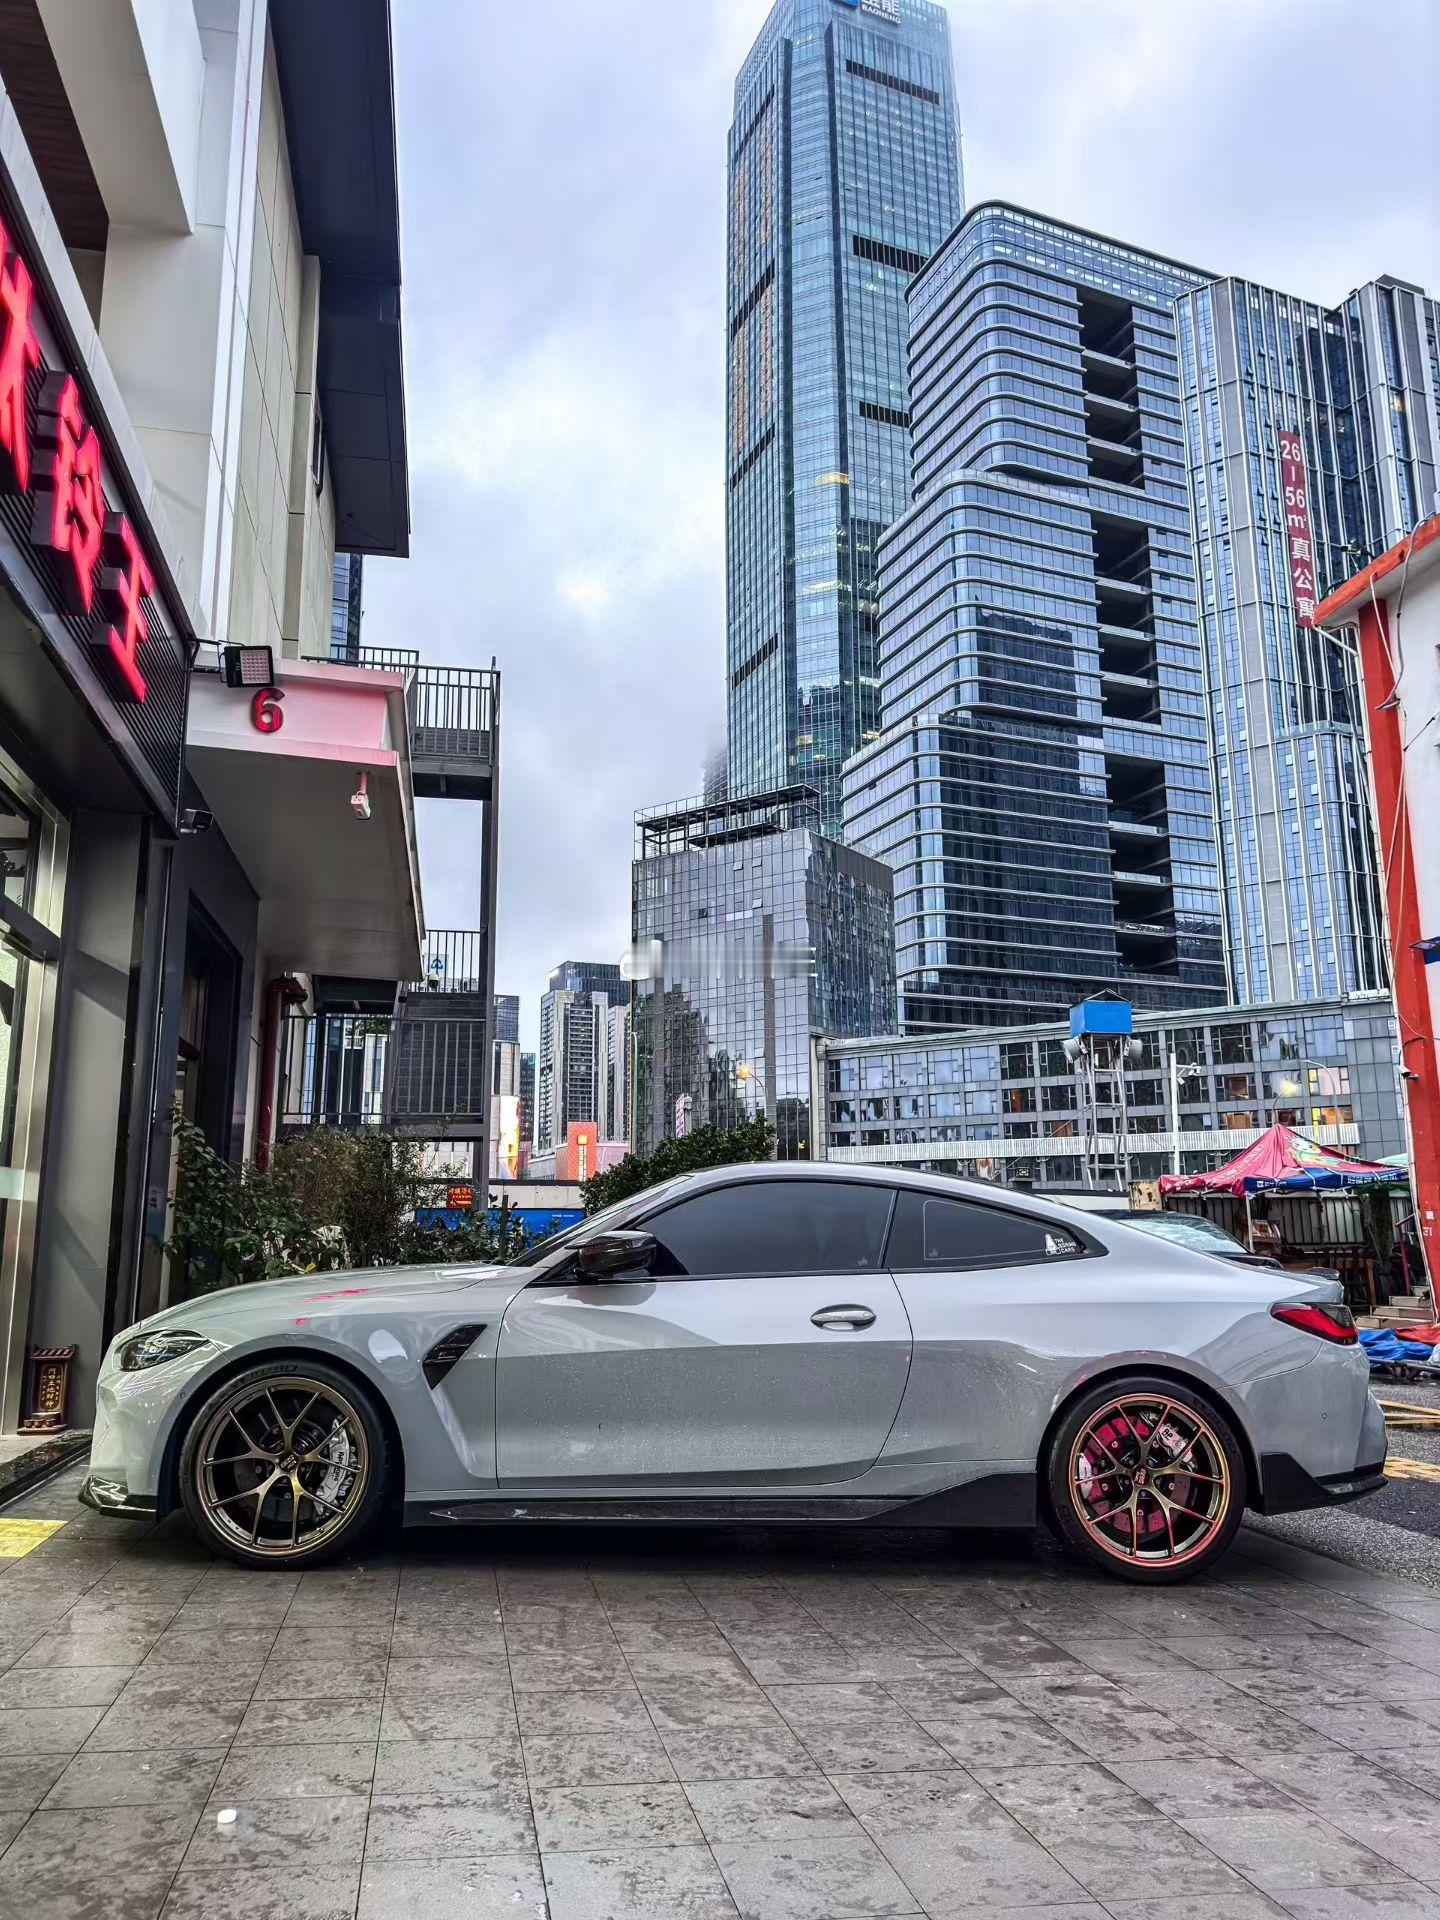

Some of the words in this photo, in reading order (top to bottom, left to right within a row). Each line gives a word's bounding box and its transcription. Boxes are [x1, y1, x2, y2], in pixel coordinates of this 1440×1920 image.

[862, 4, 901, 24] BAONENG
[251, 688, 285, 733] 6
[1162, 1429, 1173, 1440] AP
